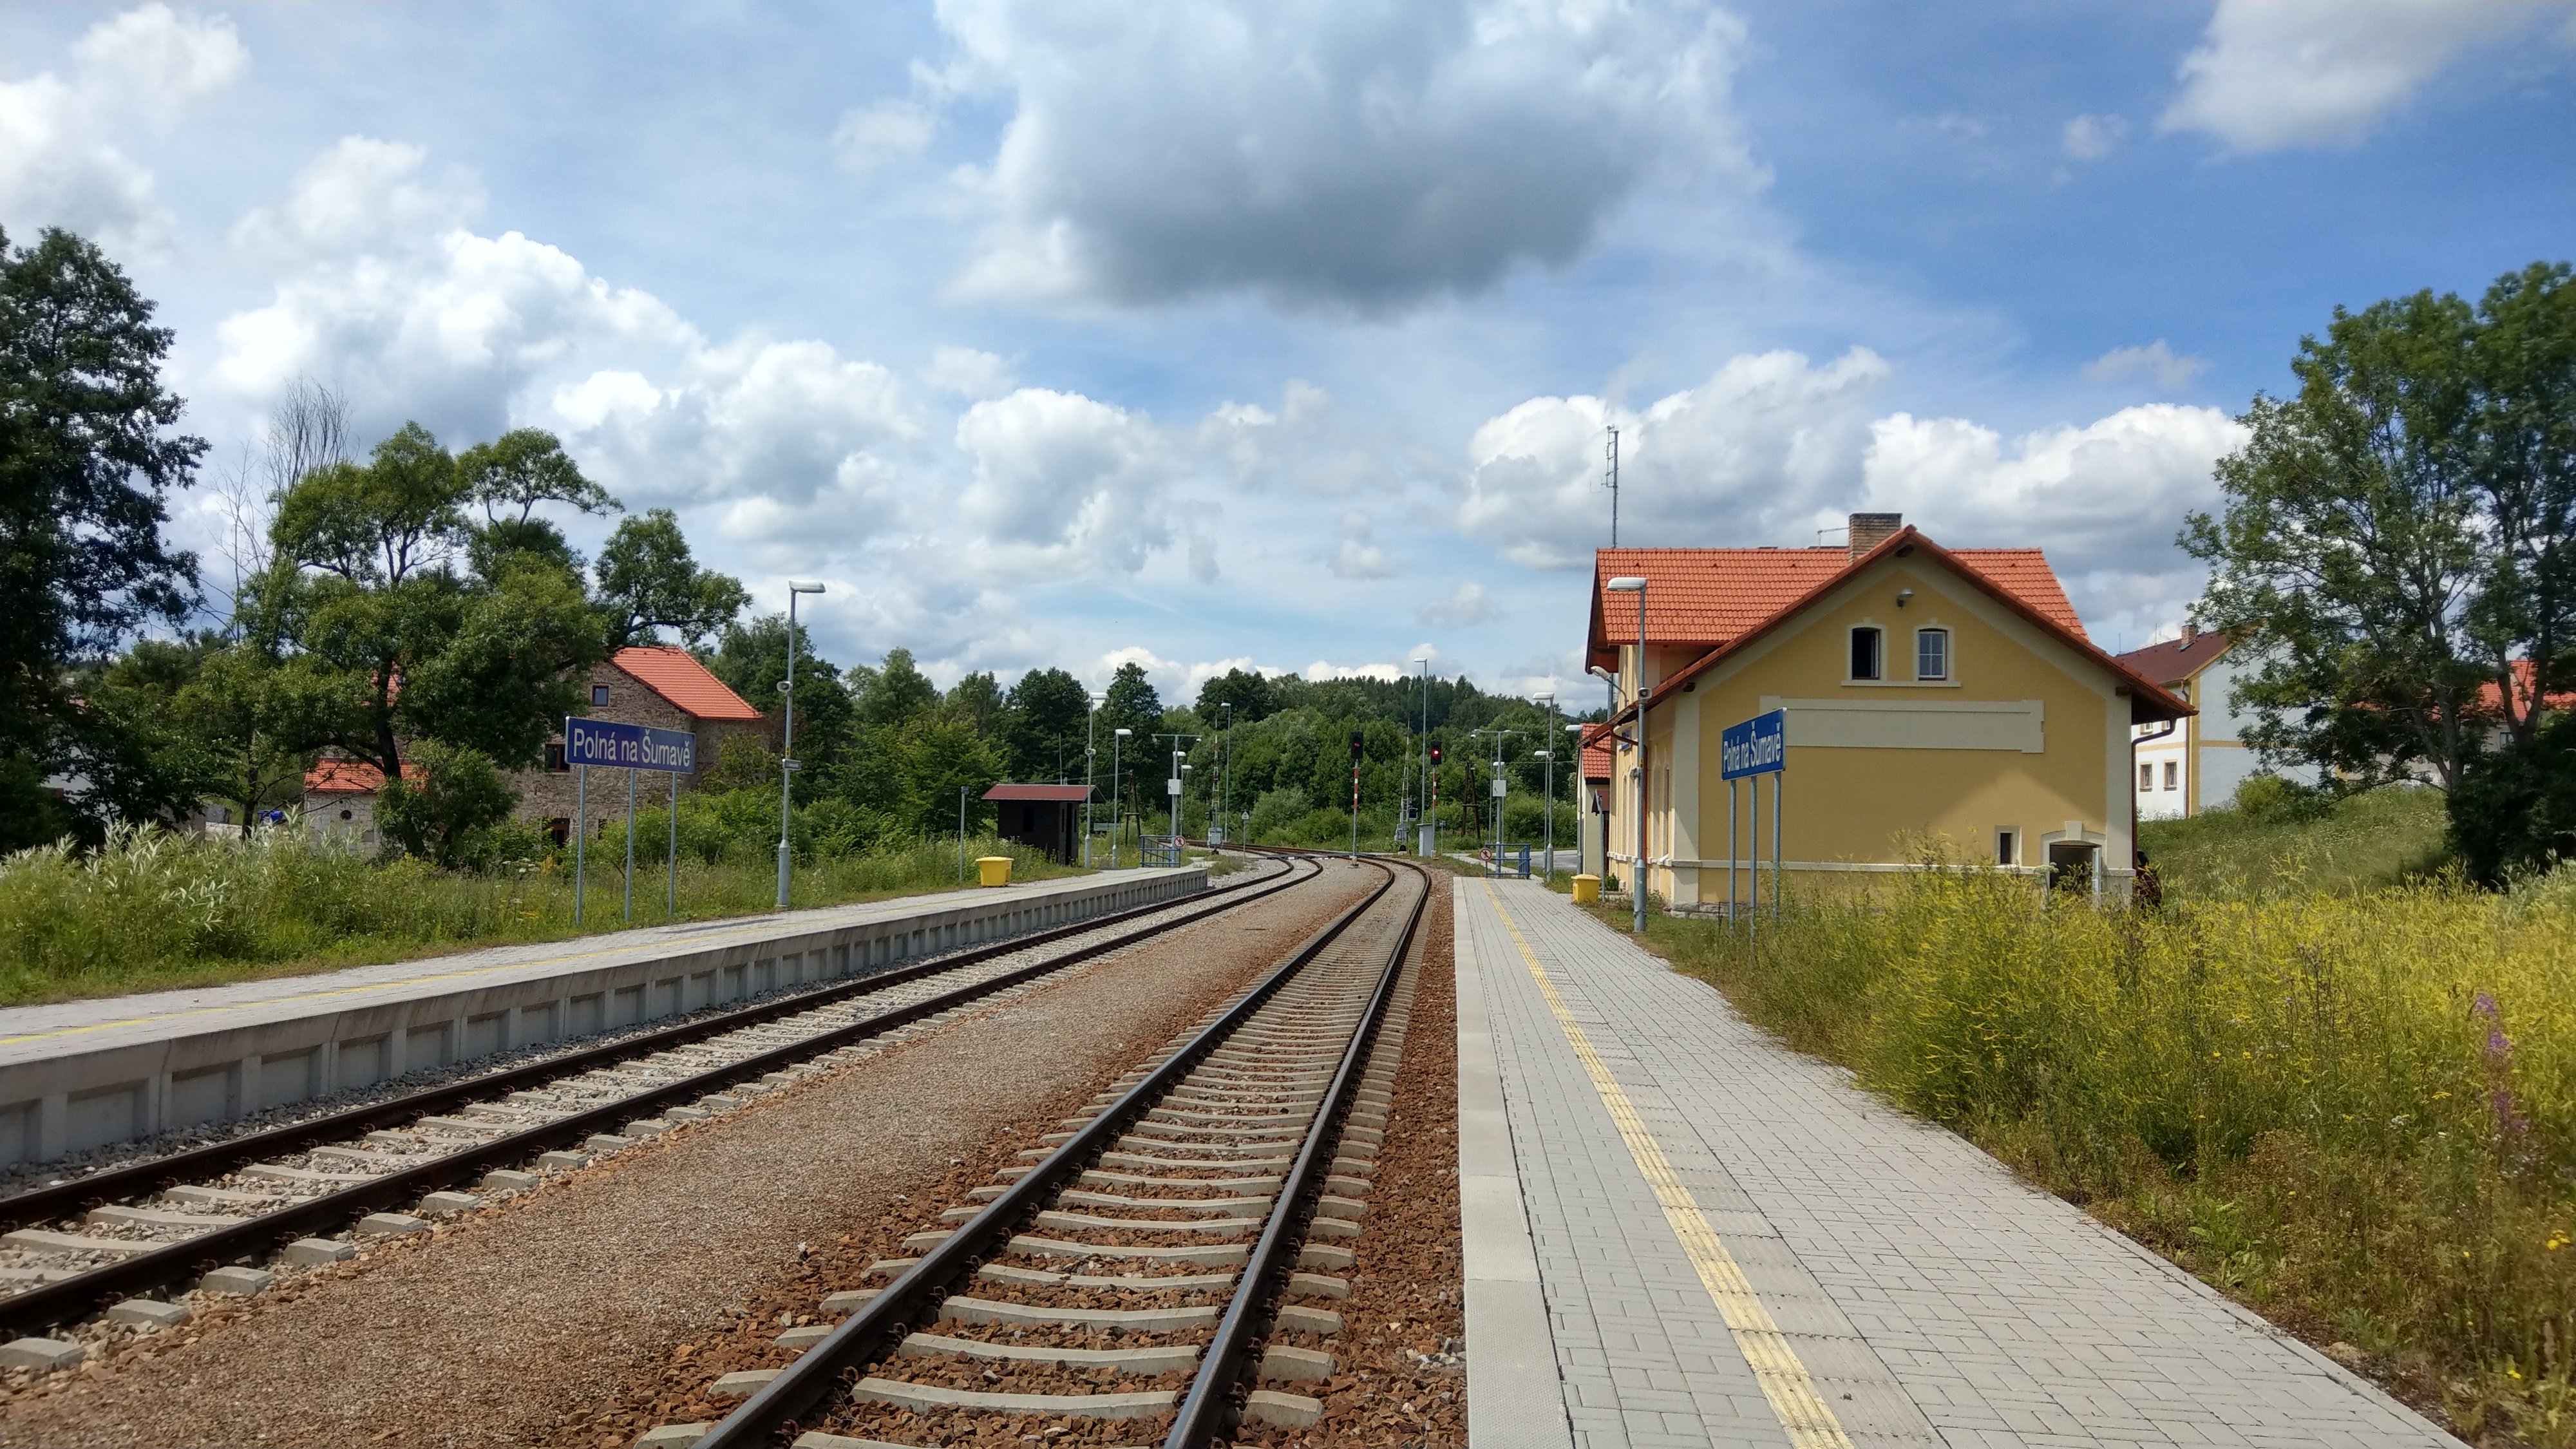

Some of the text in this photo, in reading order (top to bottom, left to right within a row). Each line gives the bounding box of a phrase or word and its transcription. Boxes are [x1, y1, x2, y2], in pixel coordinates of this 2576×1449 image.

[574, 728, 690, 767] Polná na Šumavě
[1723, 721, 1781, 773] Polná na Šumavě
